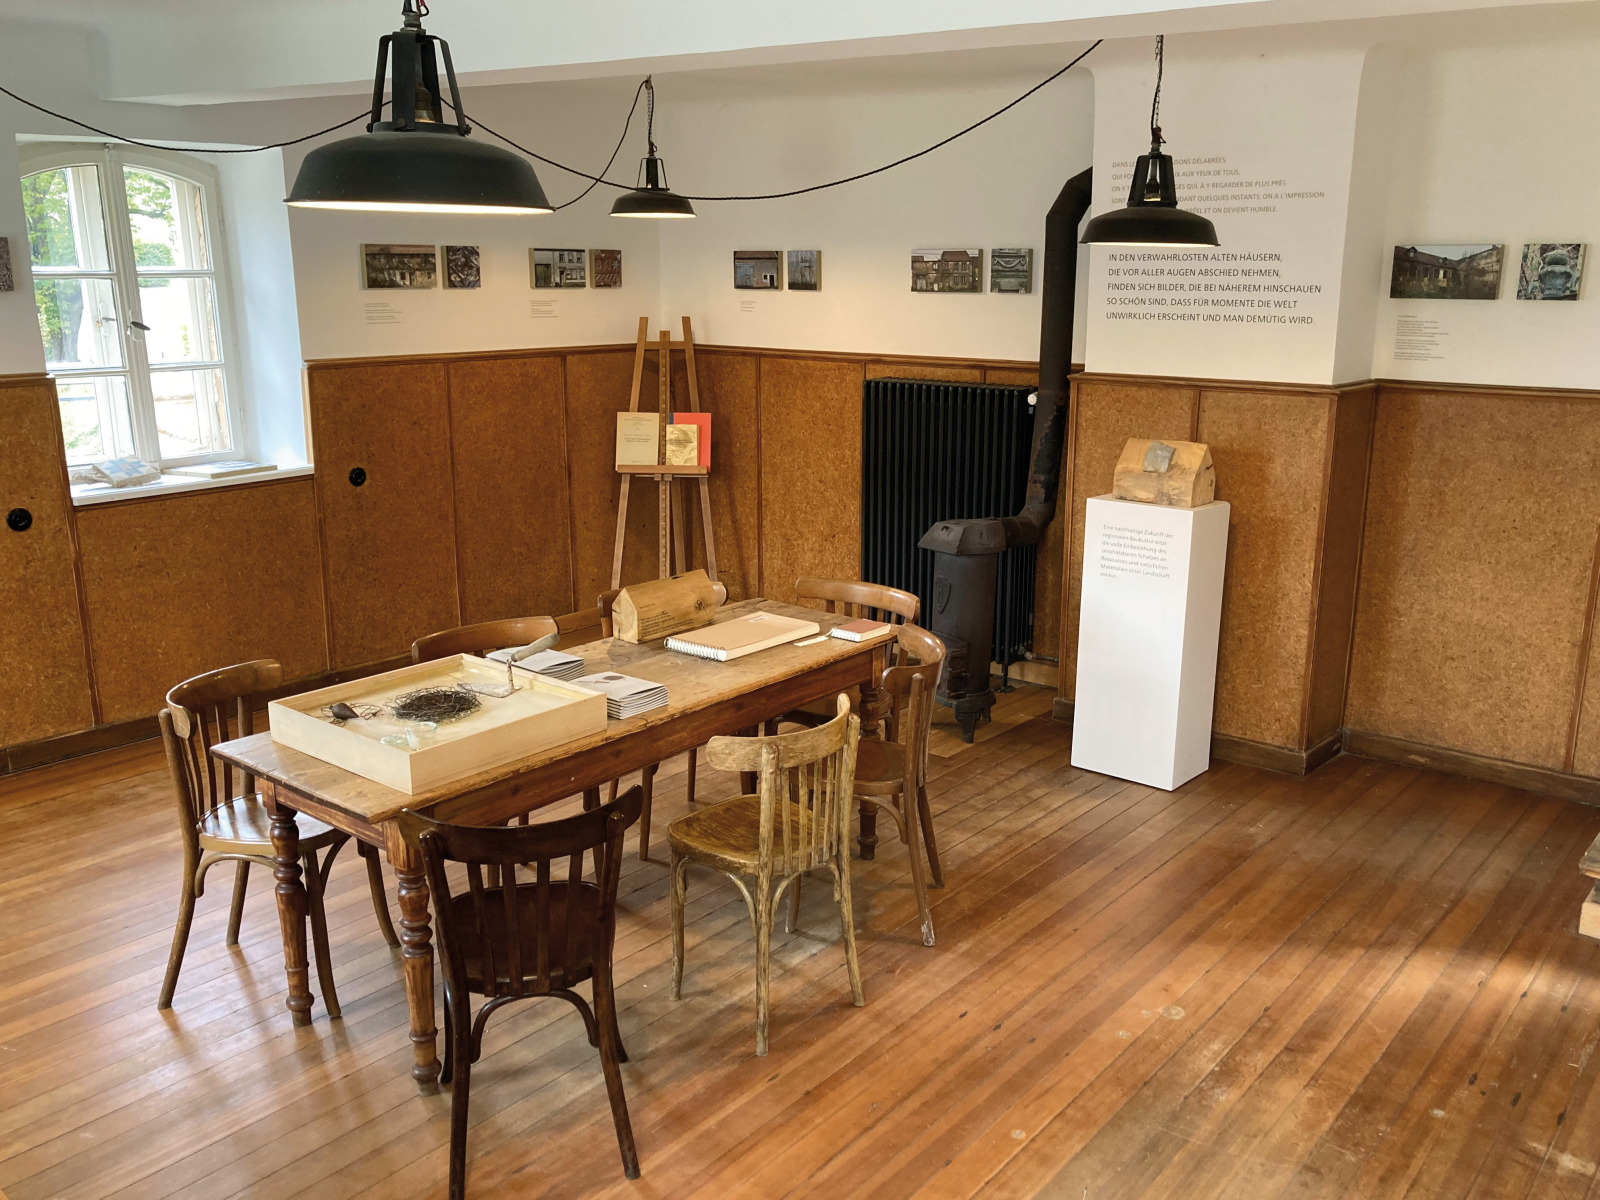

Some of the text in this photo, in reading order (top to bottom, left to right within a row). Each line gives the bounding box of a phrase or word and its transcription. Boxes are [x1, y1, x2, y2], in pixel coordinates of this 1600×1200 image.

[1137, 253, 1209, 261] VERWAHRLOSTEN
[1211, 253, 1237, 261] ALTEN
[1240, 252, 1282, 262] HÄUSERN,
[1241, 269, 1281, 278] NEHMEN,
[1138, 283, 1156, 291] SICH
[1157, 283, 1186, 292] BILDER,
[1218, 282, 1261, 292] NÄHEREM
[1263, 284, 1322, 293] HINSCHAUEN
[1119, 296, 1146, 305] SCHÖN
[1148, 298, 1169, 306] SIND,
[1170, 298, 1191, 306] DASS
[1194, 297, 1209, 307] FÜR
[1211, 299, 1255, 308] MOMENTE
[1273, 300, 1298, 308] WELT
[1106, 312, 1156, 320] UNWIRKLICH
[1157, 313, 1201, 321] ERSCHEINT
[1223, 314, 1244, 322] MAN
[1246, 314, 1286, 324] DEMÜTIG
[1288, 316, 1315, 324] WIRD.
[1114, 526, 1144, 535] nachhaltige
[1123, 544, 1156, 553] Einbeziehung
